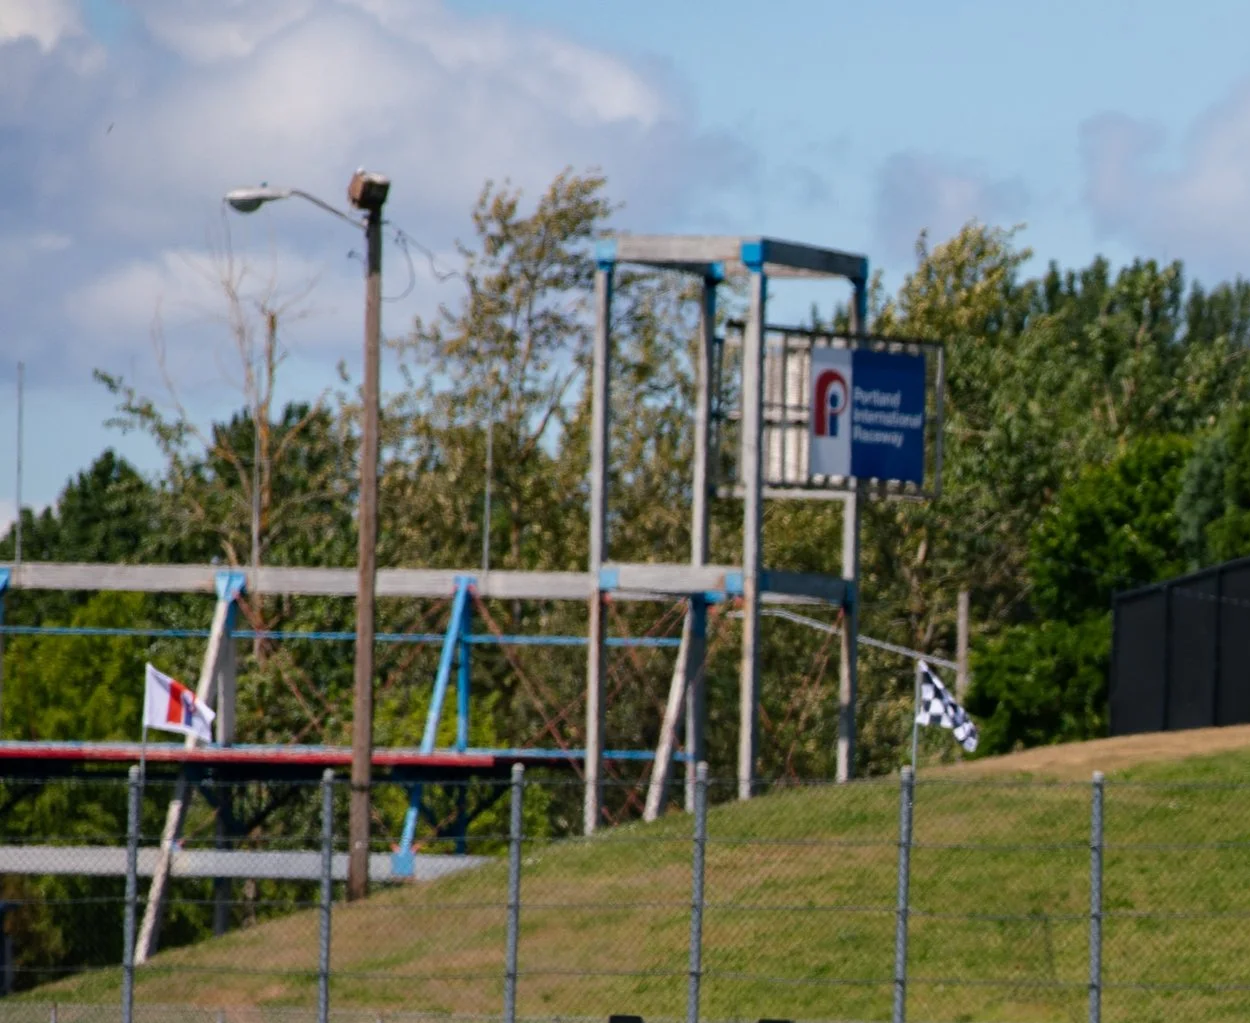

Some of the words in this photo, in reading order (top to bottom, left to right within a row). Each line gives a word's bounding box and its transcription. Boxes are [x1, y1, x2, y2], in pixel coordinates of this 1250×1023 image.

[854, 387, 902, 408] Portland
[854, 409, 923, 429] International
[853, 425, 904, 448] Raceway
